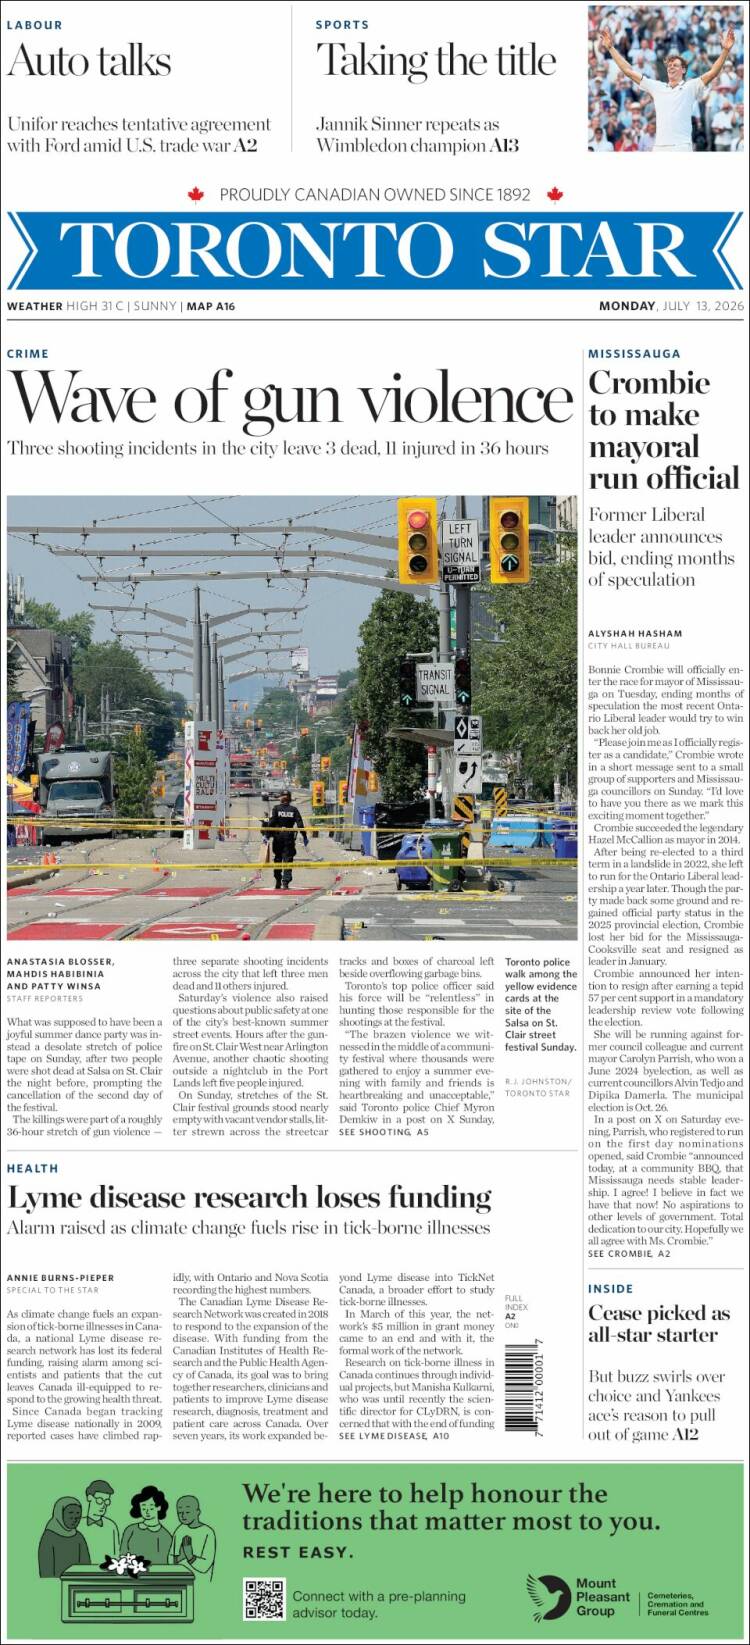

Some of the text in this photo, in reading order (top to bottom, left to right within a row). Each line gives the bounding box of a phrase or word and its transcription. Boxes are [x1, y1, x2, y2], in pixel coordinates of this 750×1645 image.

[7, 21, 61, 30] LABOUR
[316, 20, 368, 29] SPORTS
[7, 42, 171, 76] Auto talks
[317, 42, 556, 84] Taking the title
[316, 116, 499, 134] Jannik Sinner repeats as
[317, 138, 519, 156] Wimbledon champion A13
[221, 188, 530, 201] PROUDLY CANADIAN OWNED SINCE 1892
[60, 221, 696, 278] TORONTO STAR
[7, 301, 235, 310] WEATHER HIGH 31 C SUNNY MAP A16
[600, 301, 744, 312] MONDAY, JULY 13, 2026
[7, 349, 48, 358] CRIME
[589, 349, 680, 358] MISSISSAUGA
[589, 370, 710, 394] Crombie
[7, 368, 573, 437] Wave of gun violence
[589, 401, 699, 426] to make
[590, 433, 699, 464] mayoral
[590, 465, 739, 489] run official
[449, 523, 472, 534] LEFT
[449, 537, 473, 548] TURN
[444, 552, 478, 563] SIGNAL
[419, 670, 452, 680] TRANSIT
[421, 685, 450, 695] SIGNAL
[69, 958, 114, 966] BLOSSER,
[340, 957, 494, 965] tracks and boxes of charcoal left
[505, 958, 570, 968] Toronto police
[505, 970, 577, 980] walk among the
[505, 982, 577, 992] yellow evidence
[505, 994, 529, 1002] cards
[545, 994, 559, 1002] the
[505, 1006, 551, 1014] site of the
[505, 1018, 529, 1027] Salsa
[546, 1019, 557, 1027] St.
[6, 1030, 32, 1040] joyful
[75, 1030, 101, 1038] dance
[104, 1031, 128, 1040] party
[150, 1030, 161, 1038] in-
[505, 1031, 556, 1039] Clair street
[505, 1043, 576, 1053] festival Sunday.
[339, 1128, 355, 1136] SEE
[360, 1128, 411, 1136] SHOOTING,
[7, 1164, 57, 1173] HEALTH
[9, 1185, 492, 1214] Lyme disease research loses funding
[589, 1284, 632, 1293] INSIDE
[589, 1304, 730, 1324] Cease picked as
[589, 1326, 718, 1342] all-star starter
[242, 1482, 607, 1508] We're here to help honour the
[243, 1510, 660, 1536] traditions that matter most to you.
[244, 1546, 353, 1559] REST EASY.
[577, 1578, 616, 1588] Mount
[577, 1590, 630, 1602] Pleasant
[648, 1592, 694, 1600] Cemeteries,
[577, 1606, 615, 1618] Group
